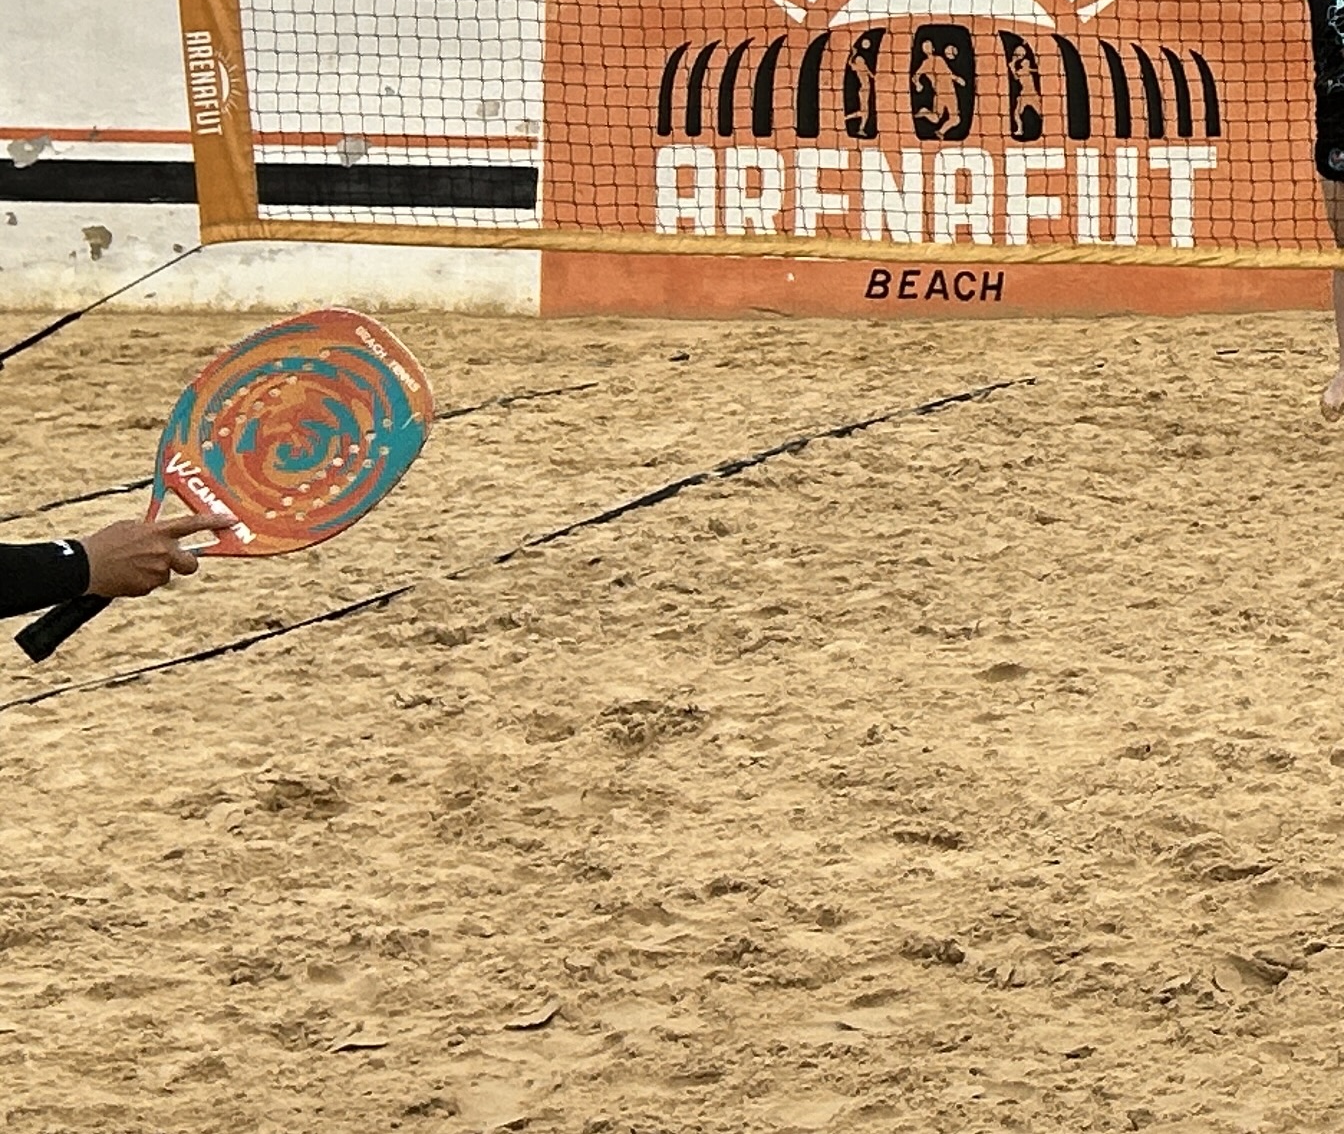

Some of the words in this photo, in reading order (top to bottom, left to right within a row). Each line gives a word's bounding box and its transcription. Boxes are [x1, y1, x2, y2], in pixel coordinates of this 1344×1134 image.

[185, 30, 223, 136] ARENAFUT
[655, 145, 1217, 252] ARENAFUT
[865, 268, 1004, 301] BEACH
[355, 326, 387, 359] BEACH
